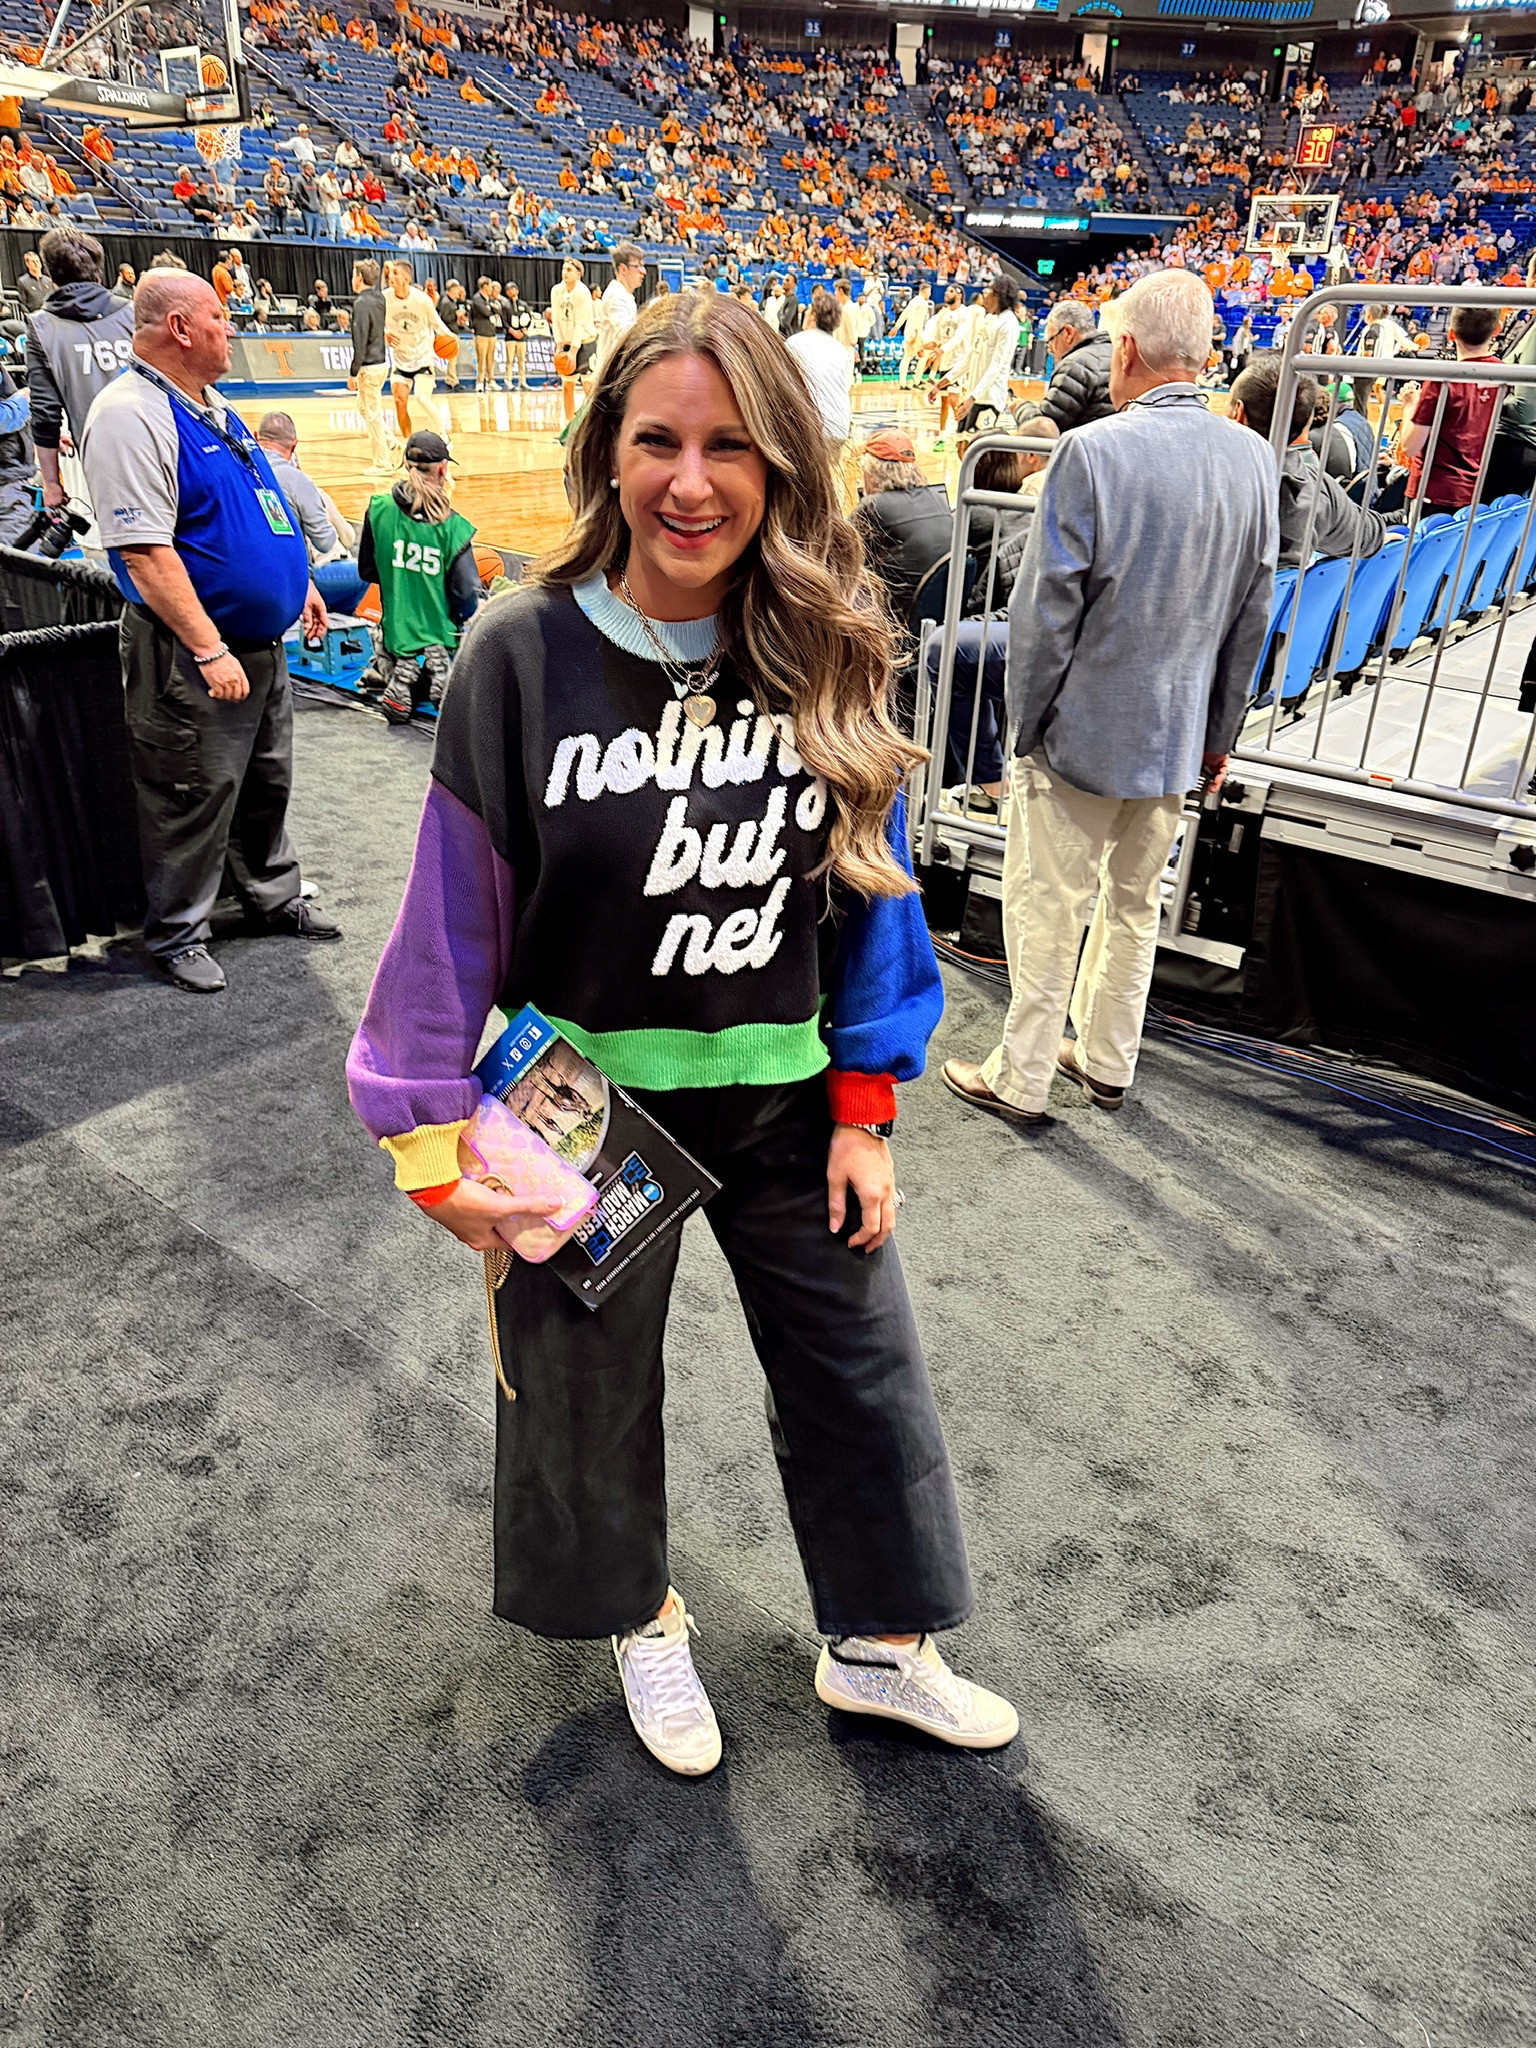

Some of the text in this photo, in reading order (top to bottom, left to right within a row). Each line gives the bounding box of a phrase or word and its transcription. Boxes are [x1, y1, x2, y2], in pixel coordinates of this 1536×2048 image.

[96, 85, 150, 109] SPALDING
[1303, 141, 1328, 162] 30
[74, 340, 133, 375] 769
[392, 539, 442, 577] 125
[643, 785, 788, 896] but
[651, 876, 793, 976] net
[574, 1180, 631, 1243] MADNESS
[603, 1190, 649, 1239] MARCH
